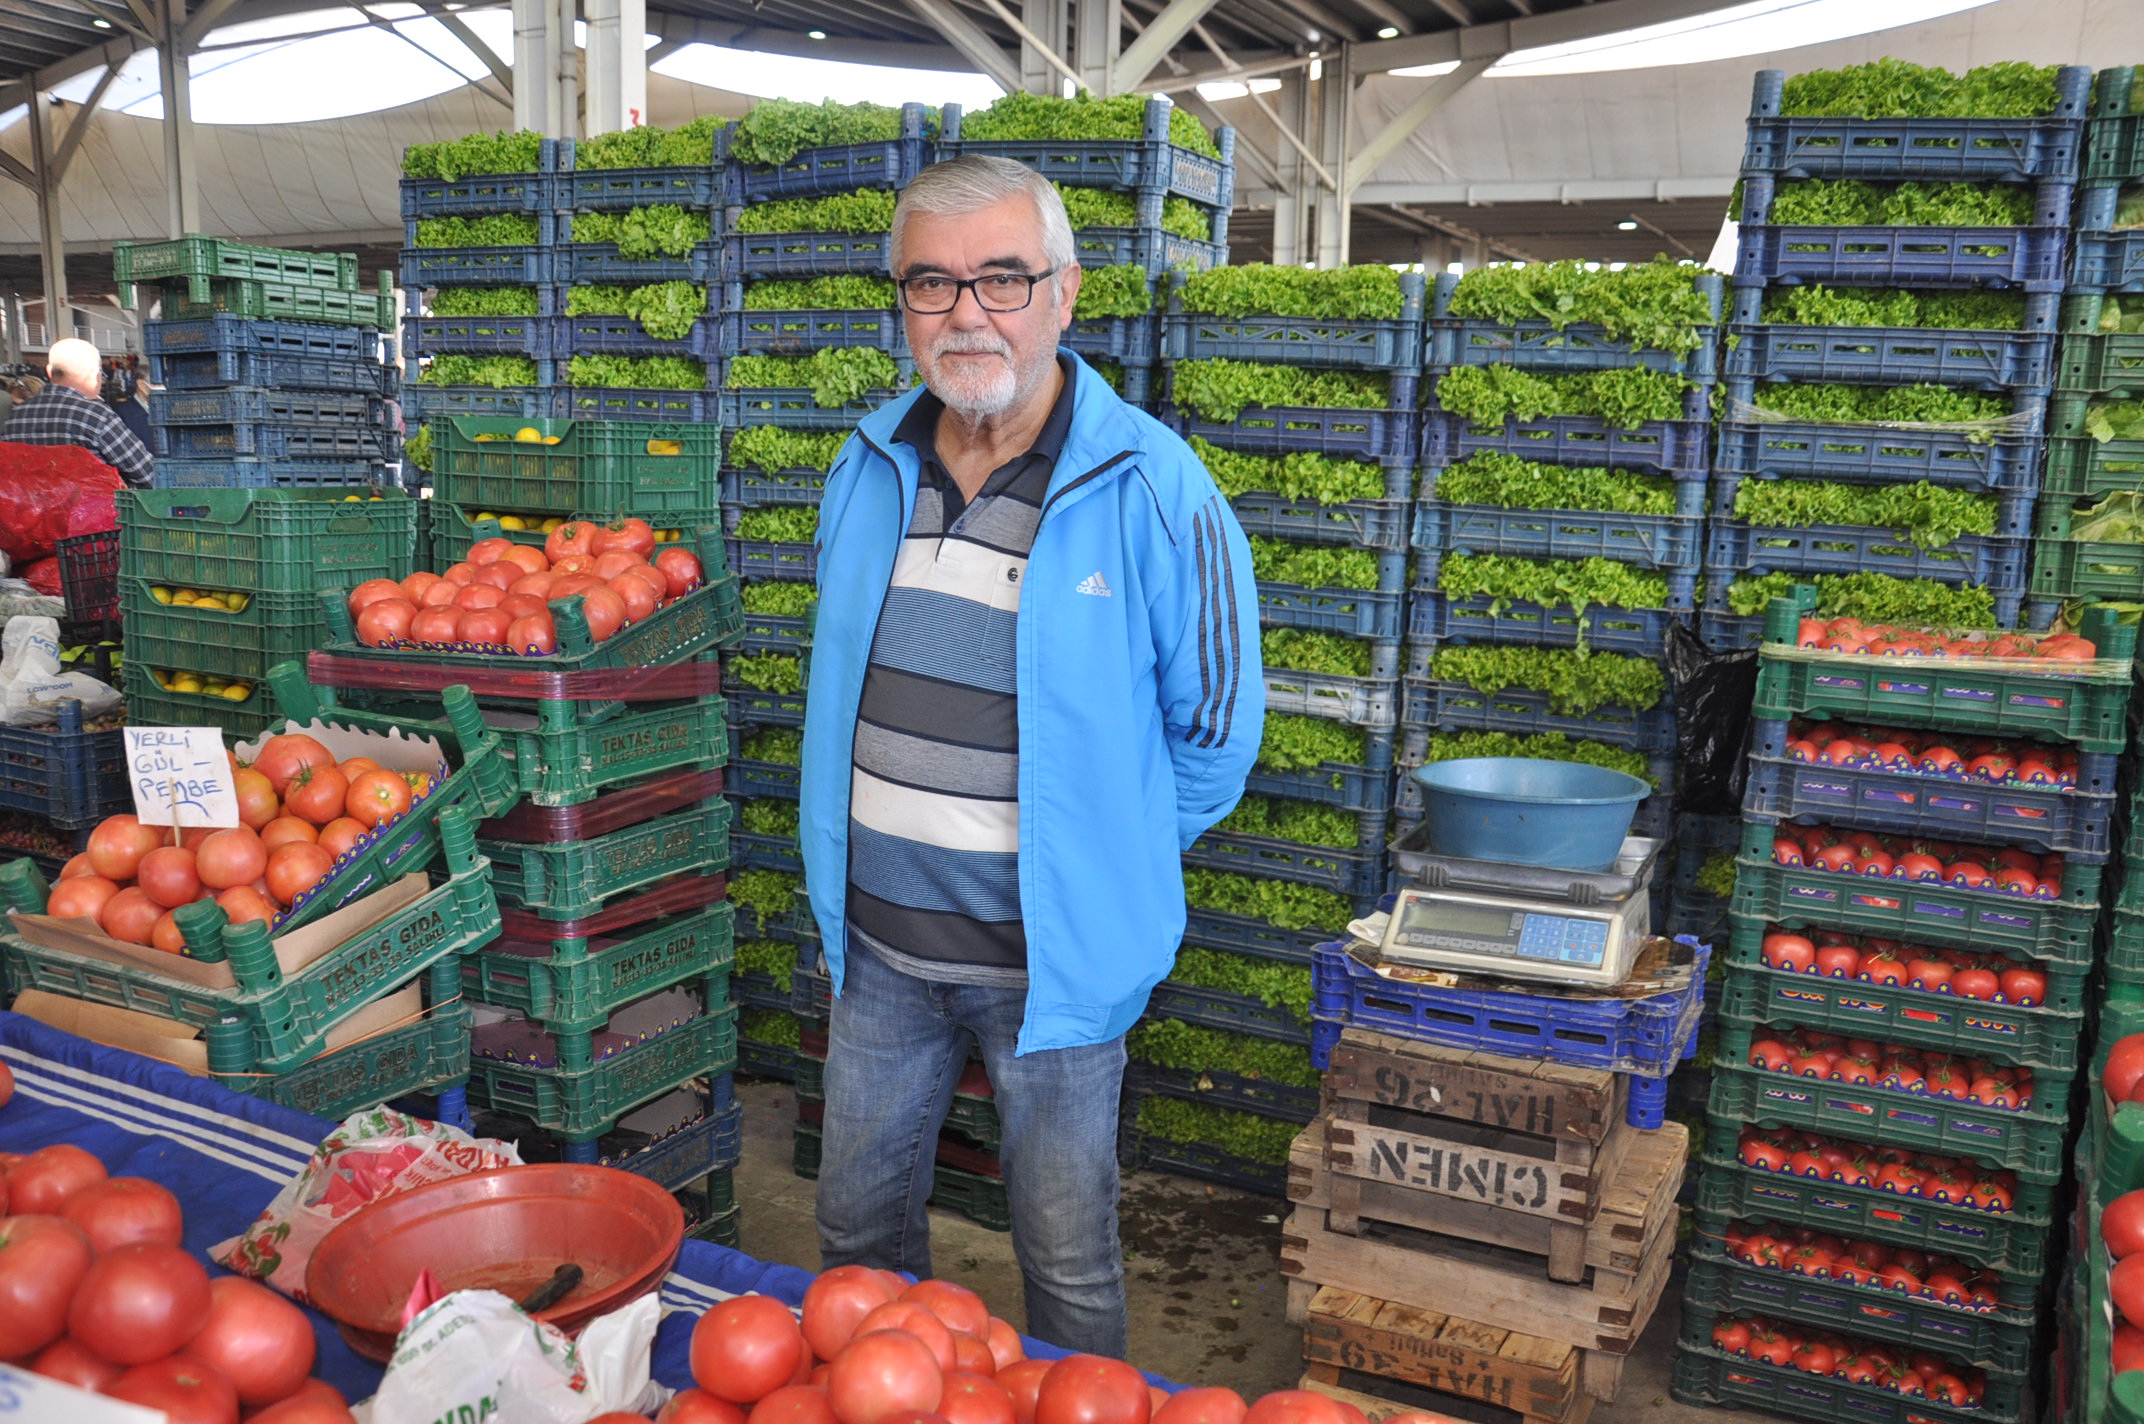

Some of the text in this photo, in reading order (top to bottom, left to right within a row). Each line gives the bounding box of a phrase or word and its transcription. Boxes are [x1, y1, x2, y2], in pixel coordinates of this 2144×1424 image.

[1075, 584, 1113, 598] adidas
[134, 749, 184, 774] GÜL
[138, 778, 224, 802] PEMBE
[321, 909, 444, 992] TEKTAS GIDA
[612, 933, 697, 977] TEKTAS GIDA
[1466, 1090, 1555, 1134] HAL
